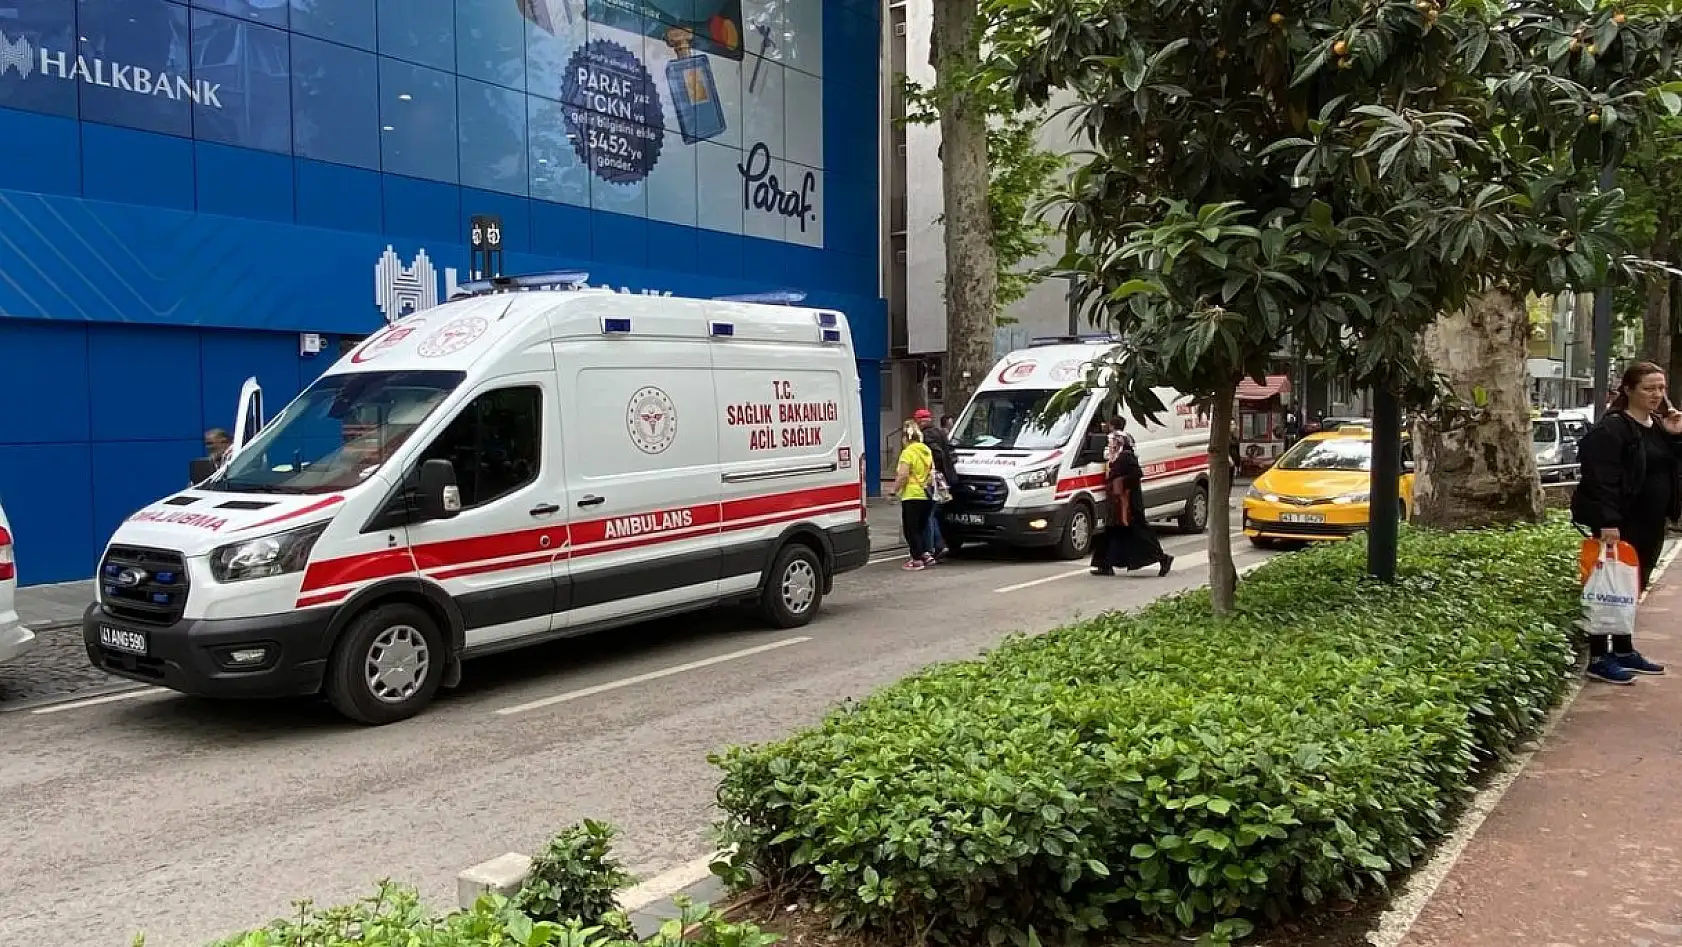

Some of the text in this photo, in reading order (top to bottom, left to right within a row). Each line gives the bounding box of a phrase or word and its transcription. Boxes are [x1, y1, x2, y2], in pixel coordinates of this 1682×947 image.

[40, 48, 222, 108] HALKBANK
[578, 67, 631, 98] PARAF
[582, 90, 631, 120] TCKN
[772, 380, 795, 400] T.C.
[727, 400, 838, 425] SAĞLIK BAKANLIĞI
[749, 424, 822, 450] ACİL SAĞLIK
[605, 510, 693, 539] AMBULANS
[103, 627, 111, 643] 41
[112, 629, 129, 647] ANG
